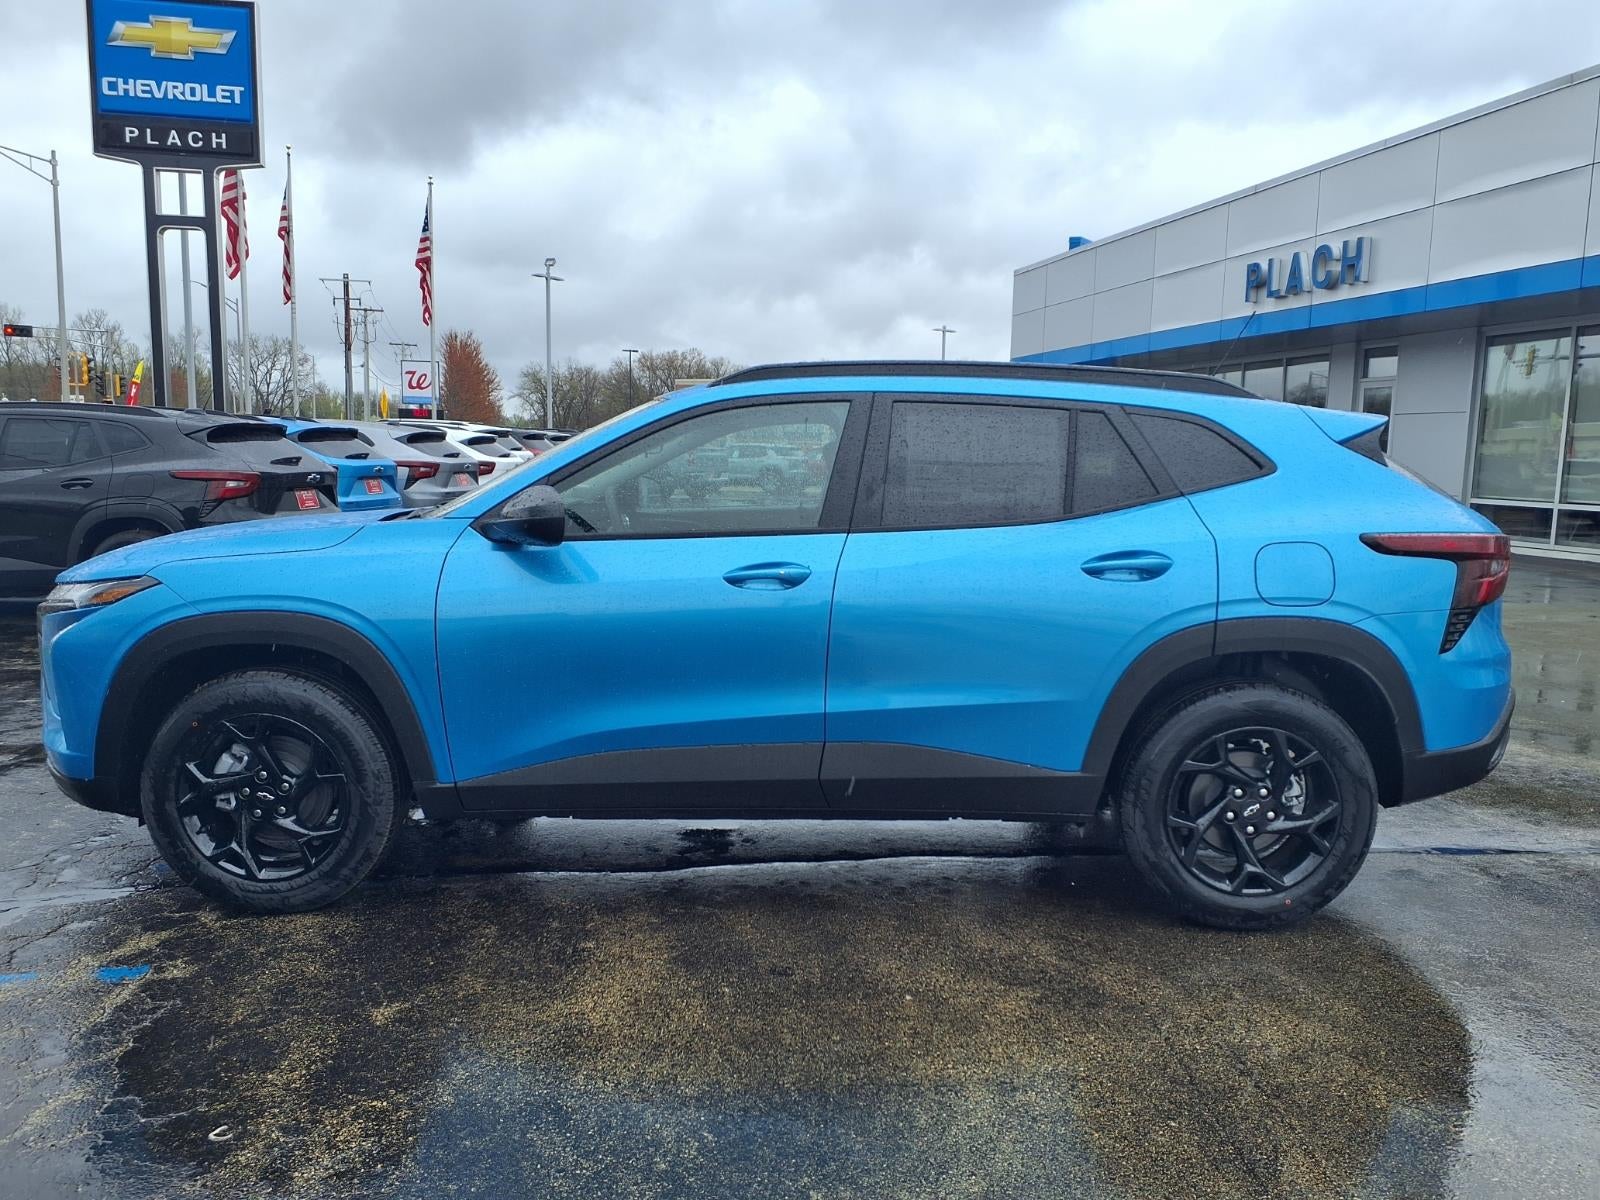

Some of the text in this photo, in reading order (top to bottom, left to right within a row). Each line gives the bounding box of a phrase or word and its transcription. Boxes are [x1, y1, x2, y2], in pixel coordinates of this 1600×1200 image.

[102, 77, 244, 104] CHEVROLET
[125, 127, 227, 149] PLACH
[1245, 236, 1372, 303] PLACH
